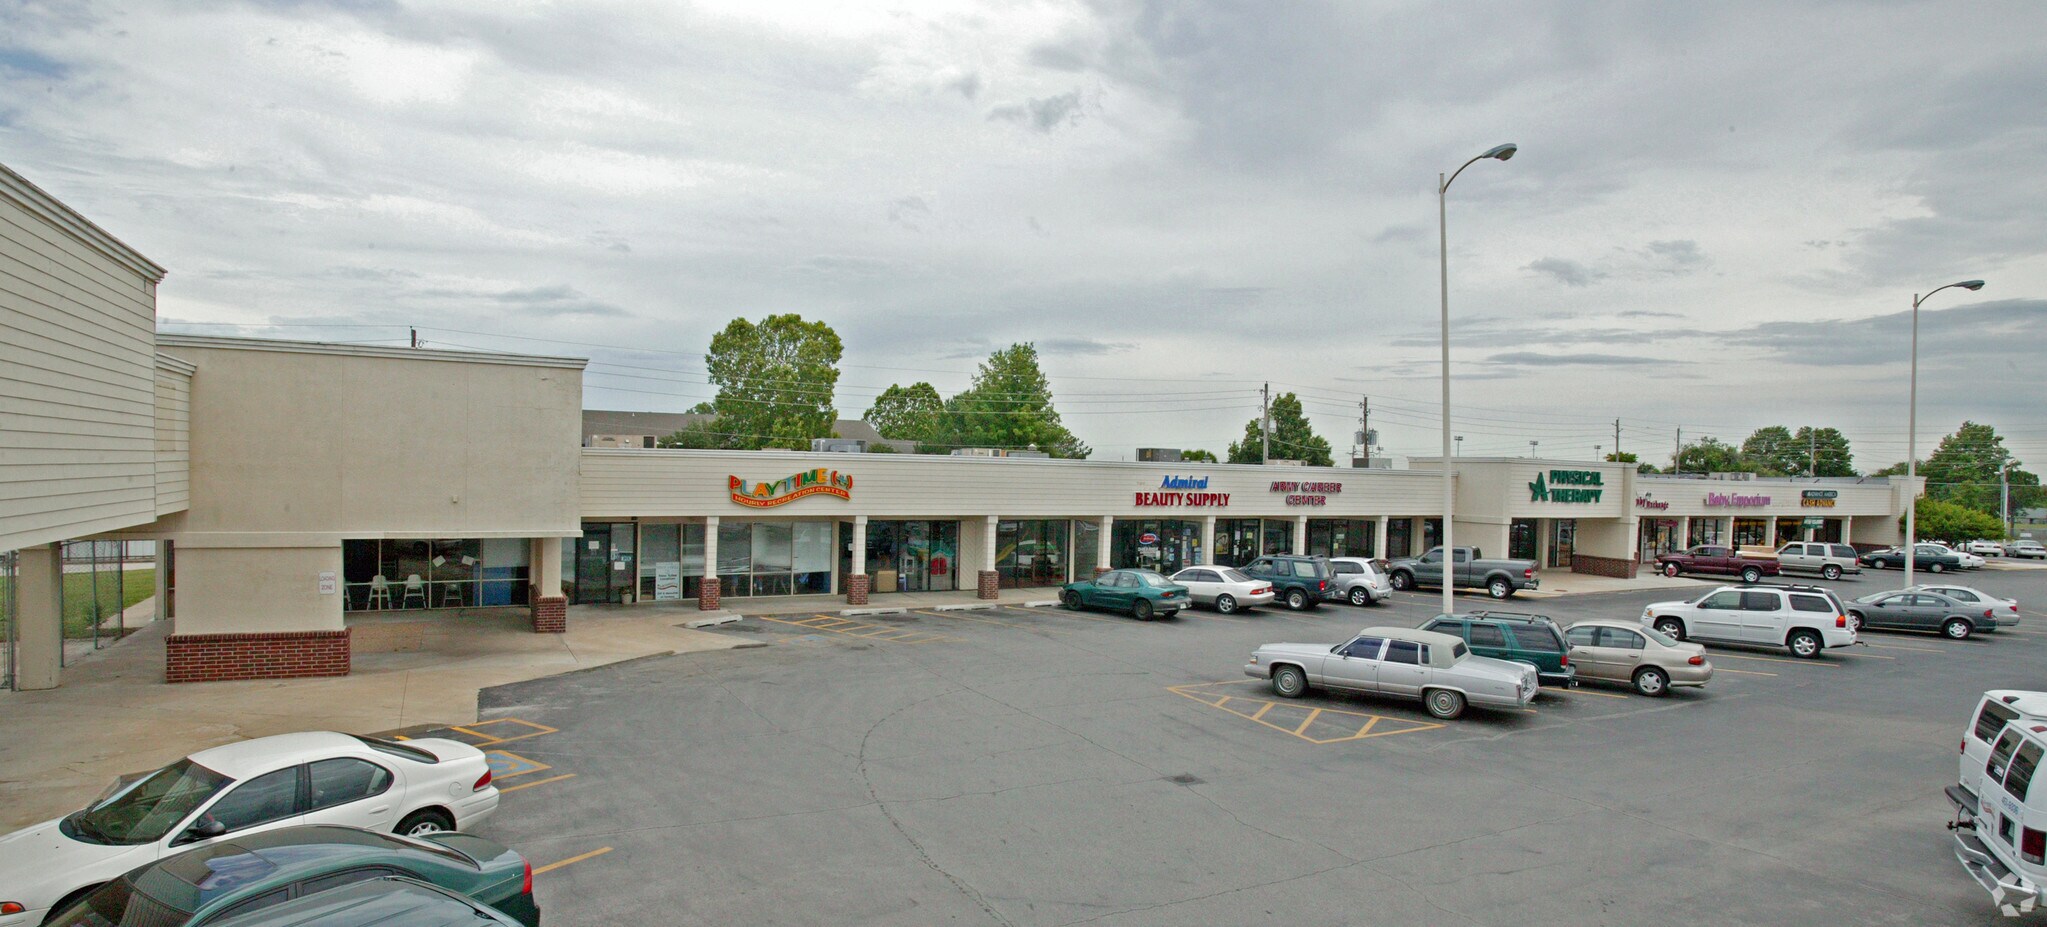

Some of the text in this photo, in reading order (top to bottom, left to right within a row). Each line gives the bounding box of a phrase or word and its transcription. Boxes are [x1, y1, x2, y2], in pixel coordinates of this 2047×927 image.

[729, 468, 828, 498] PLAYTIME
[1160, 475, 1208, 489] Admiral
[1550, 470, 1604, 486] PHYSICAL
[1269, 481, 1342, 493] ARMY CAREER
[735, 486, 847, 506] HOURLY RECREATION CENTER
[1135, 492, 1230, 507] BEAUTY SUPPLY
[1286, 494, 1326, 506] CENTER
[1550, 488, 1602, 503] THERAPY
